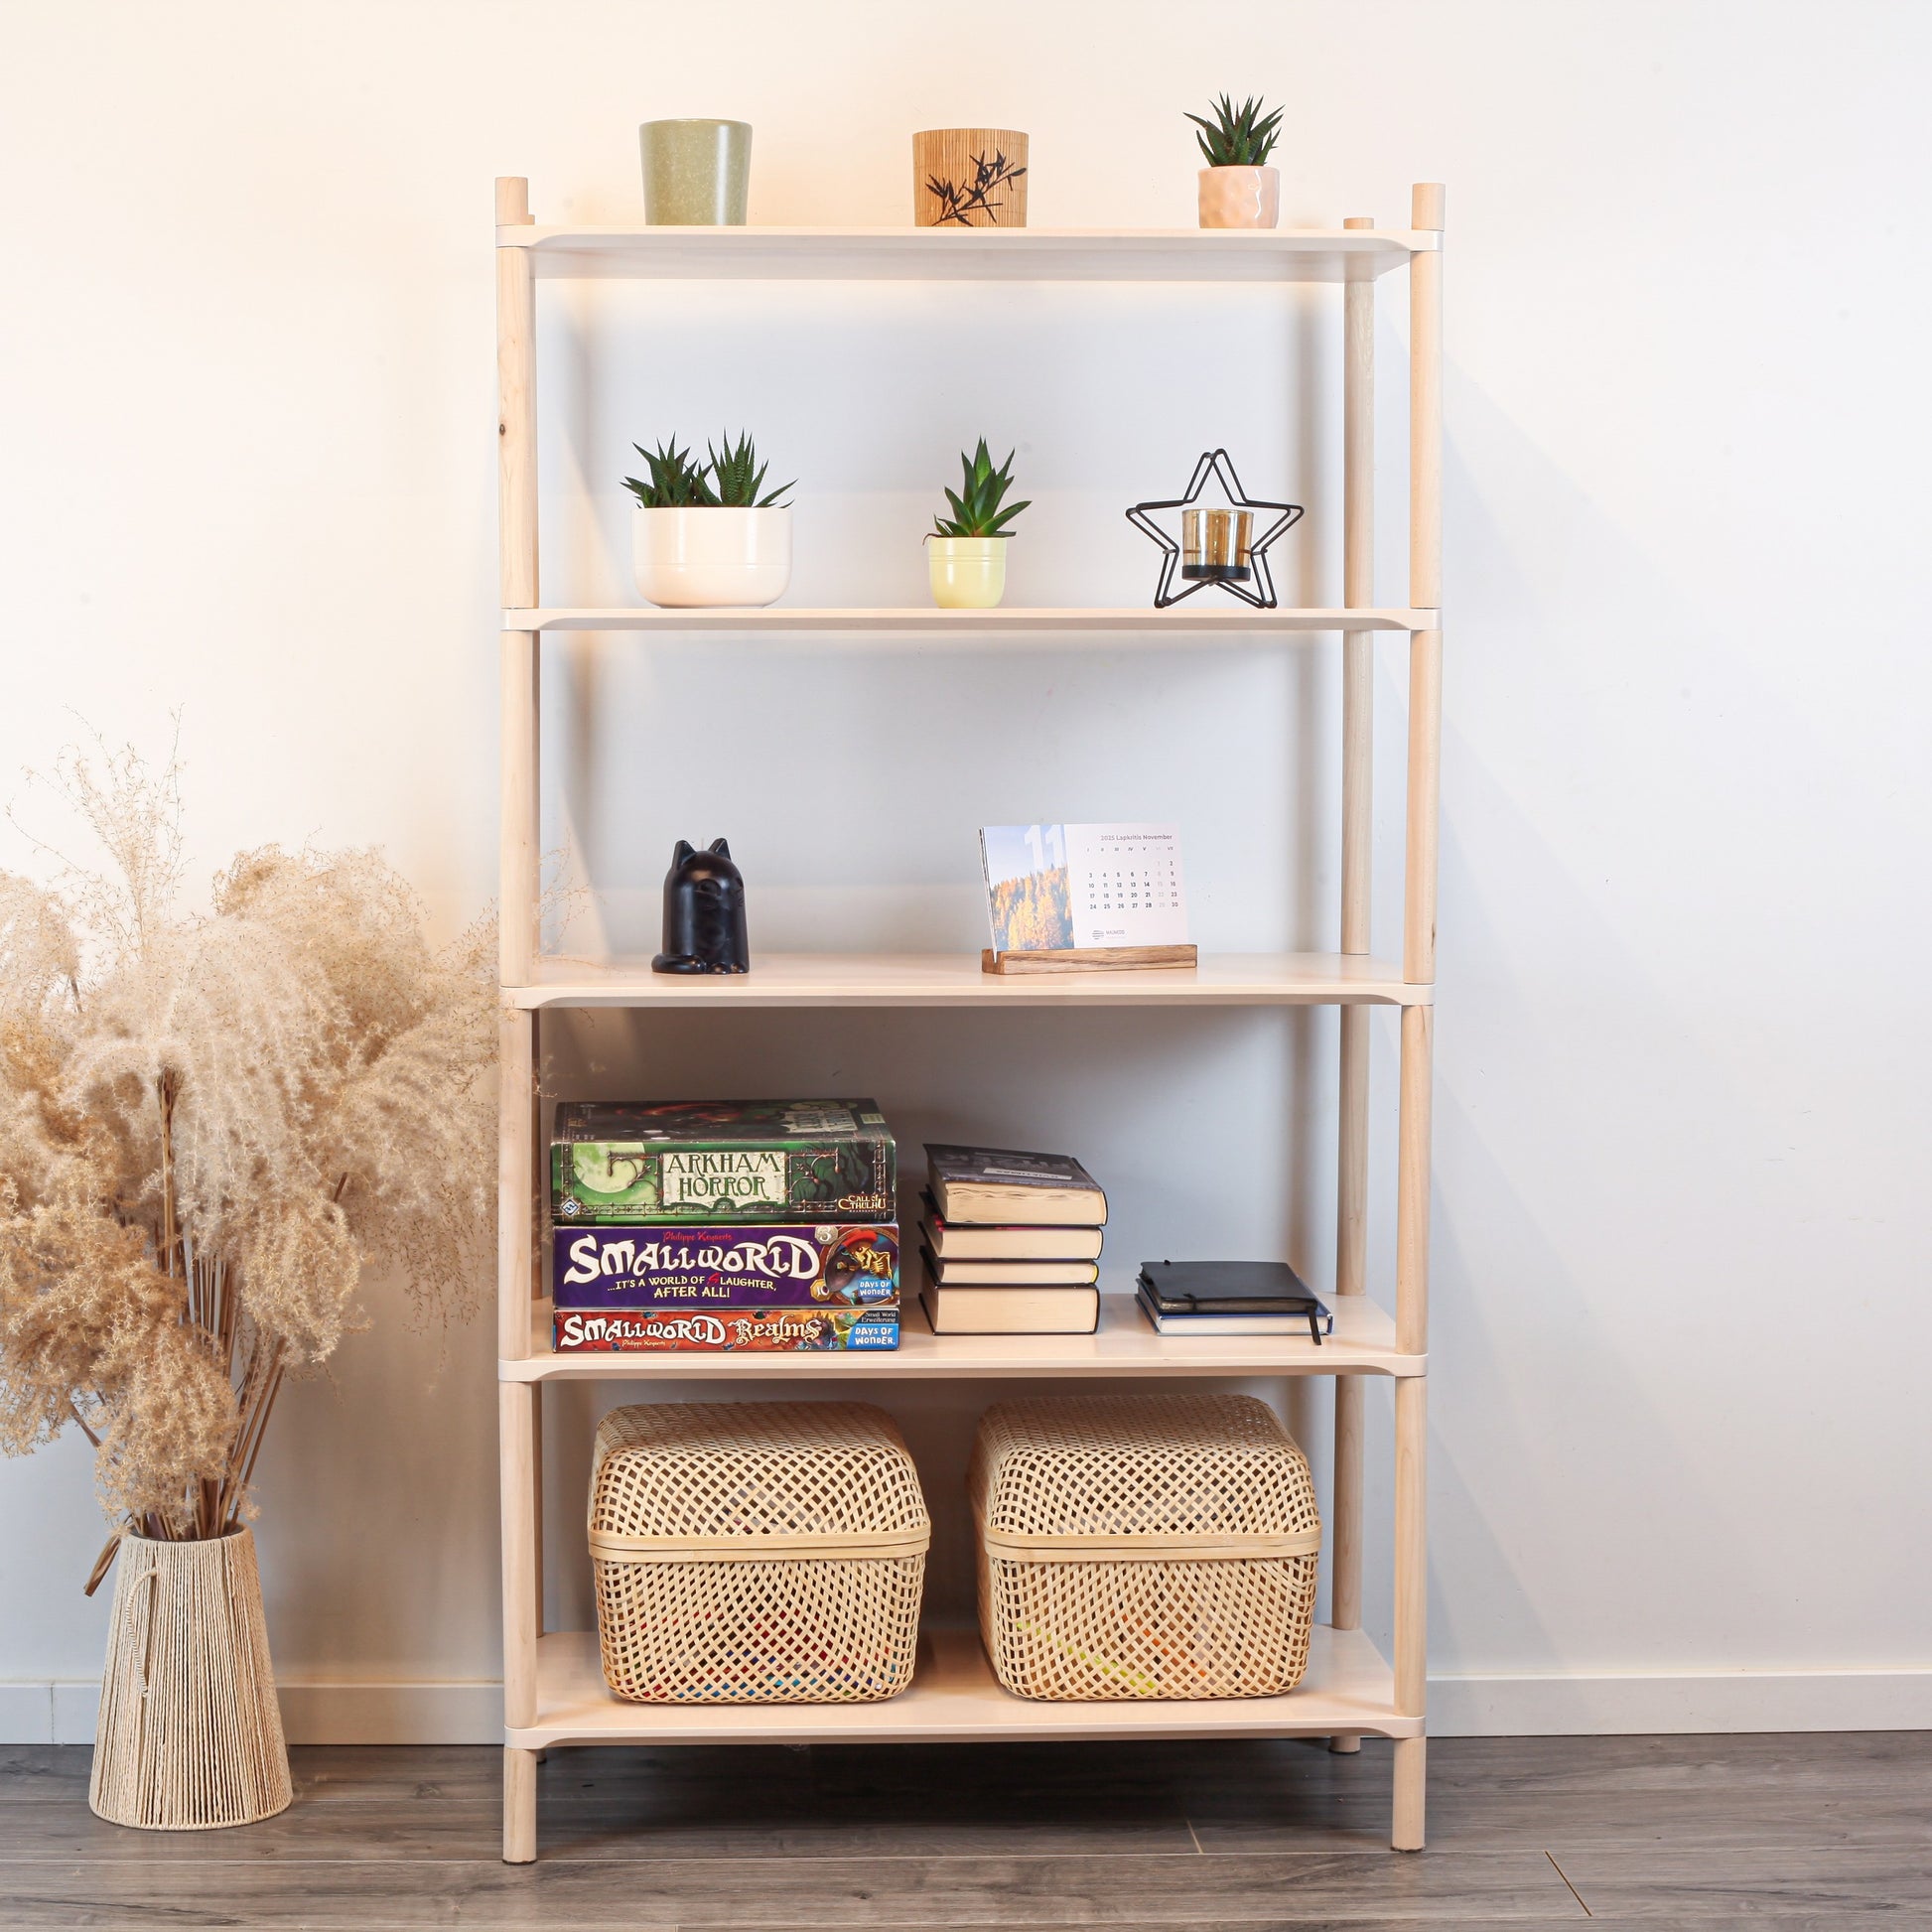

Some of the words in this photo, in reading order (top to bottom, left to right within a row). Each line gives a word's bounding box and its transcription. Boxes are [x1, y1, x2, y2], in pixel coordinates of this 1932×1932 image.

[1024, 824, 1063, 870] 11
[666, 1153, 781, 1176] ARKHAM
[679, 1176, 770, 1200] HORROR
[838, 1197, 886, 1210] CTHULHU
[663, 1231, 695, 1245] Philippe
[638, 1278, 646, 1287] A
[648, 1275, 688, 1286] WORLD
[690, 1275, 705, 1284] OF
[654, 1287, 697, 1299] AFTER
[701, 1287, 730, 1298] ALL!
[817, 1286, 829, 1297] 10
[727, 1314, 823, 1346] Realms
[855, 1327, 879, 1336] DAYS
[854, 1336, 894, 1345] WONDER
